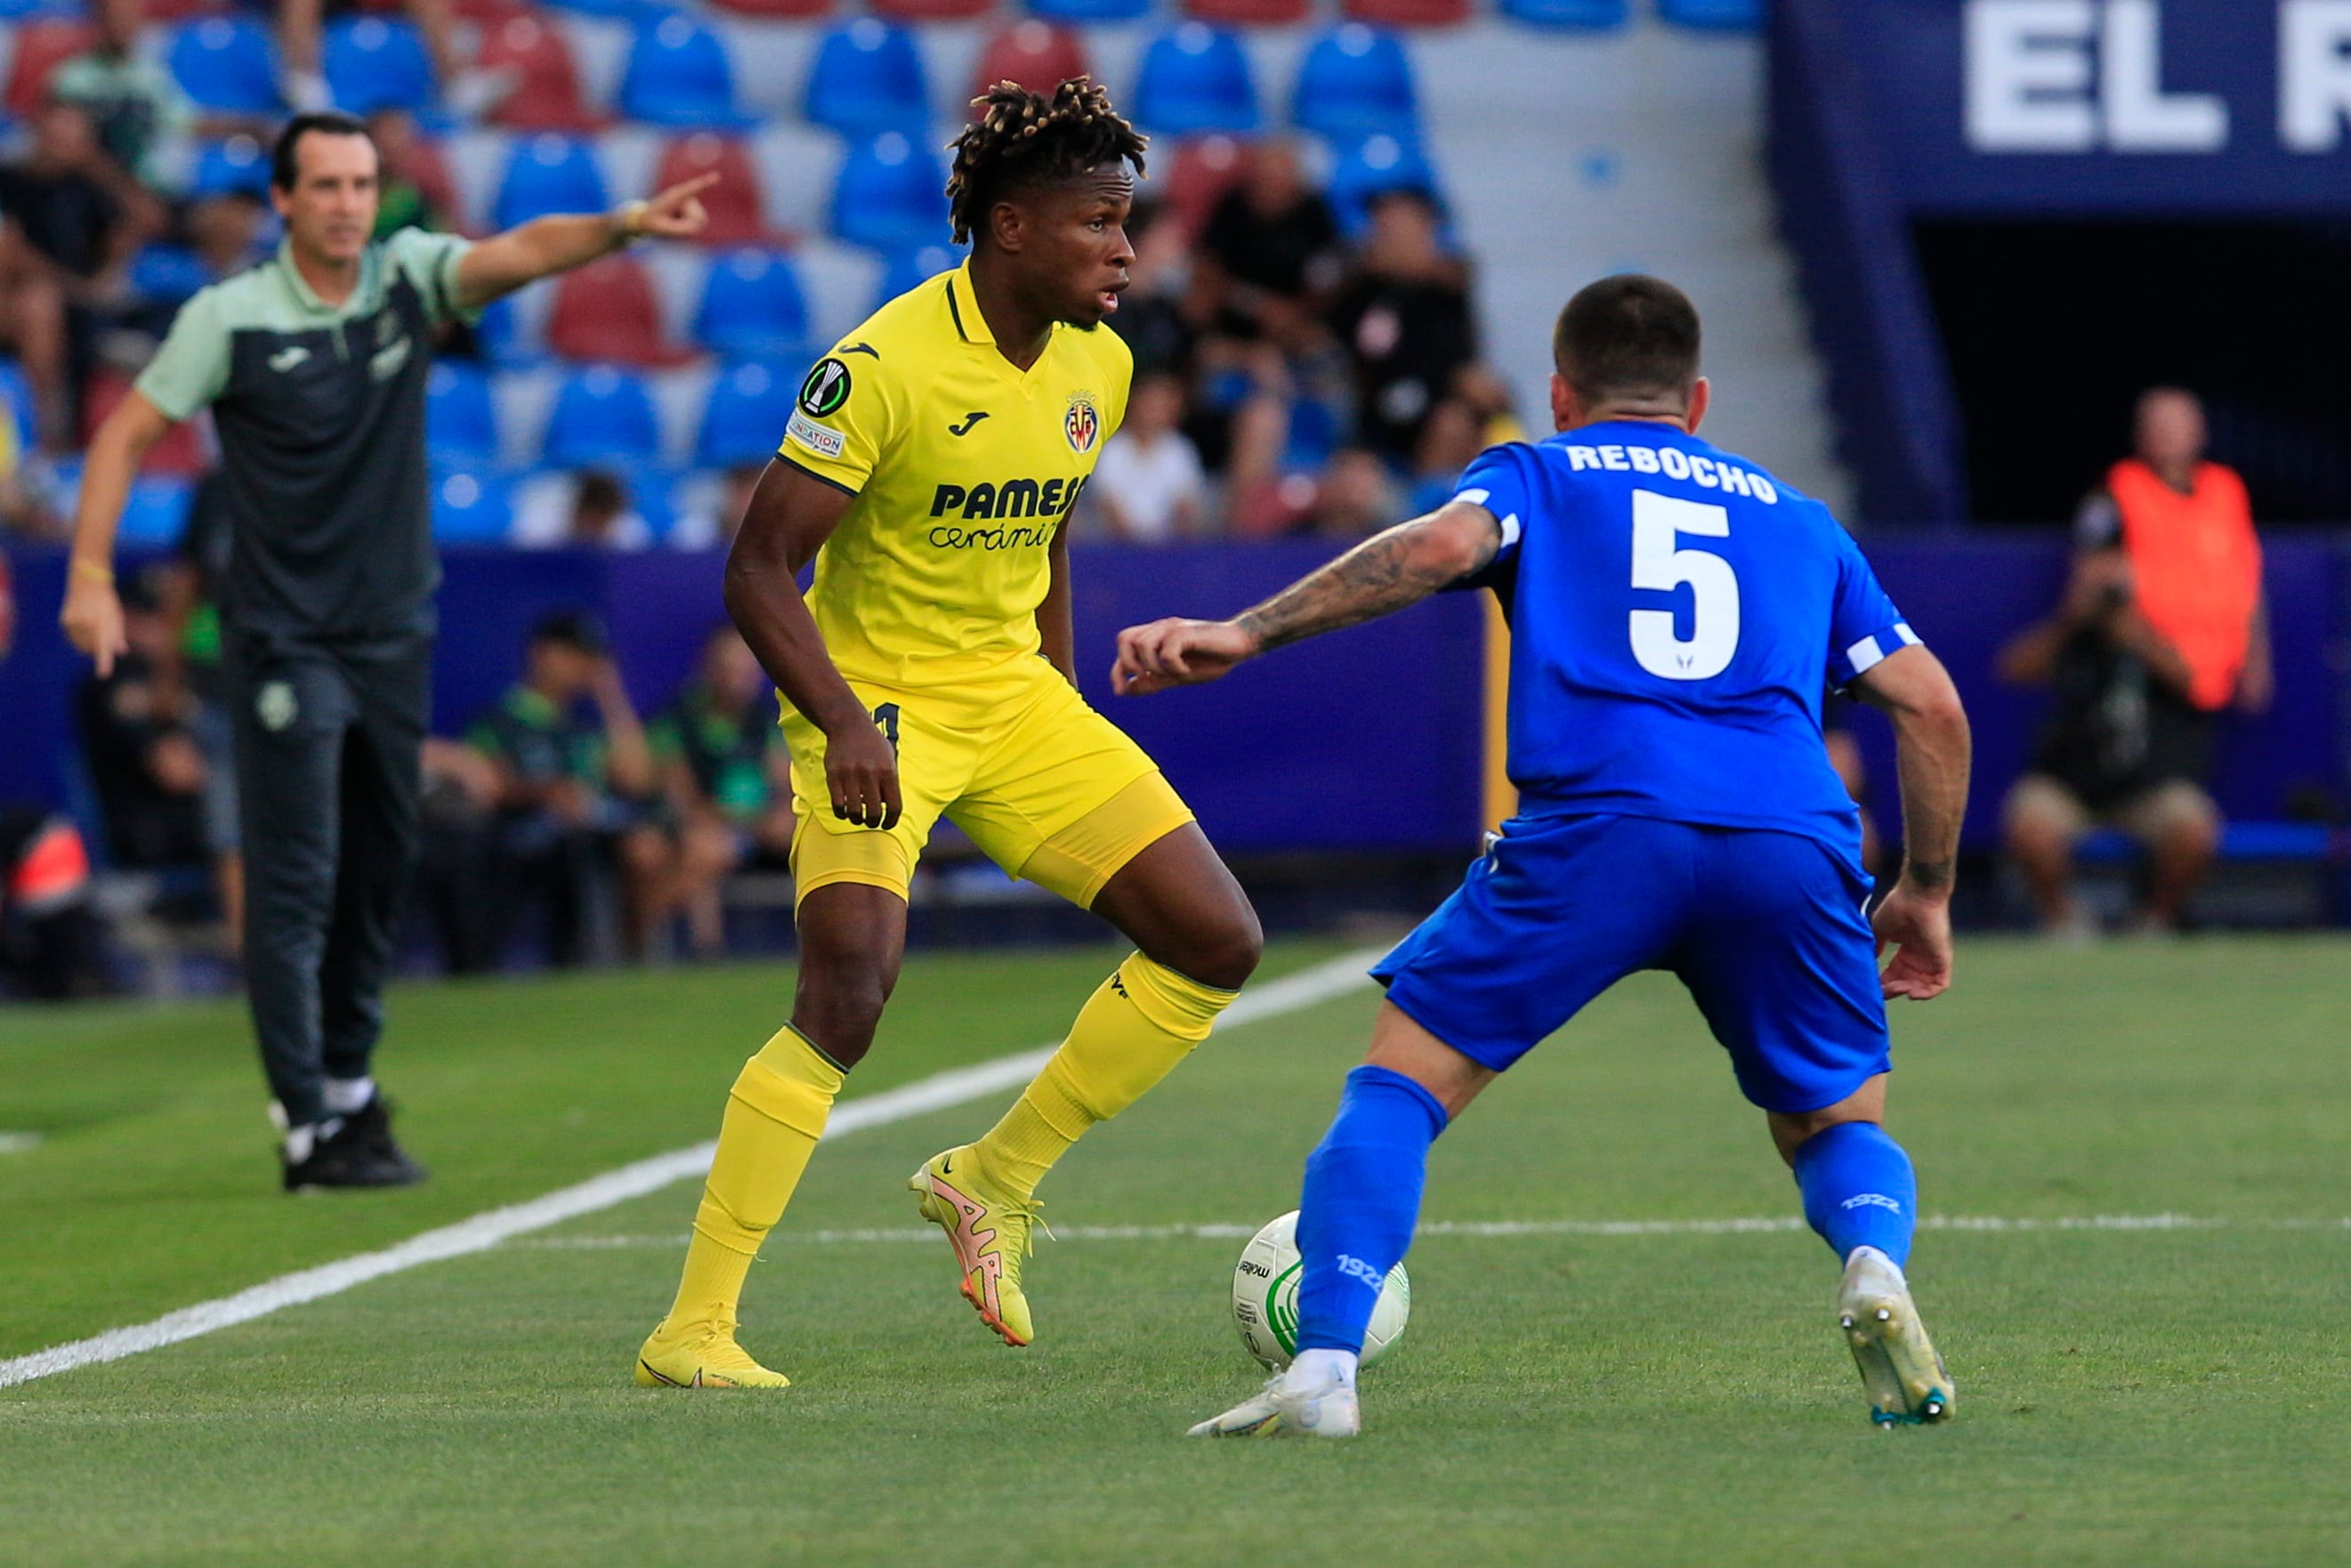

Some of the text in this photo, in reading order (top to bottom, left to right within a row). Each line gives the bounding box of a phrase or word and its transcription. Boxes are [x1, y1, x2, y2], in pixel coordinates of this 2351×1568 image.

[1964, 0, 2227, 152] EL
[930, 474, 1090, 519] PAMES
[1565, 445, 1779, 505] REBOCHO
[1629, 489, 1741, 680] 5
